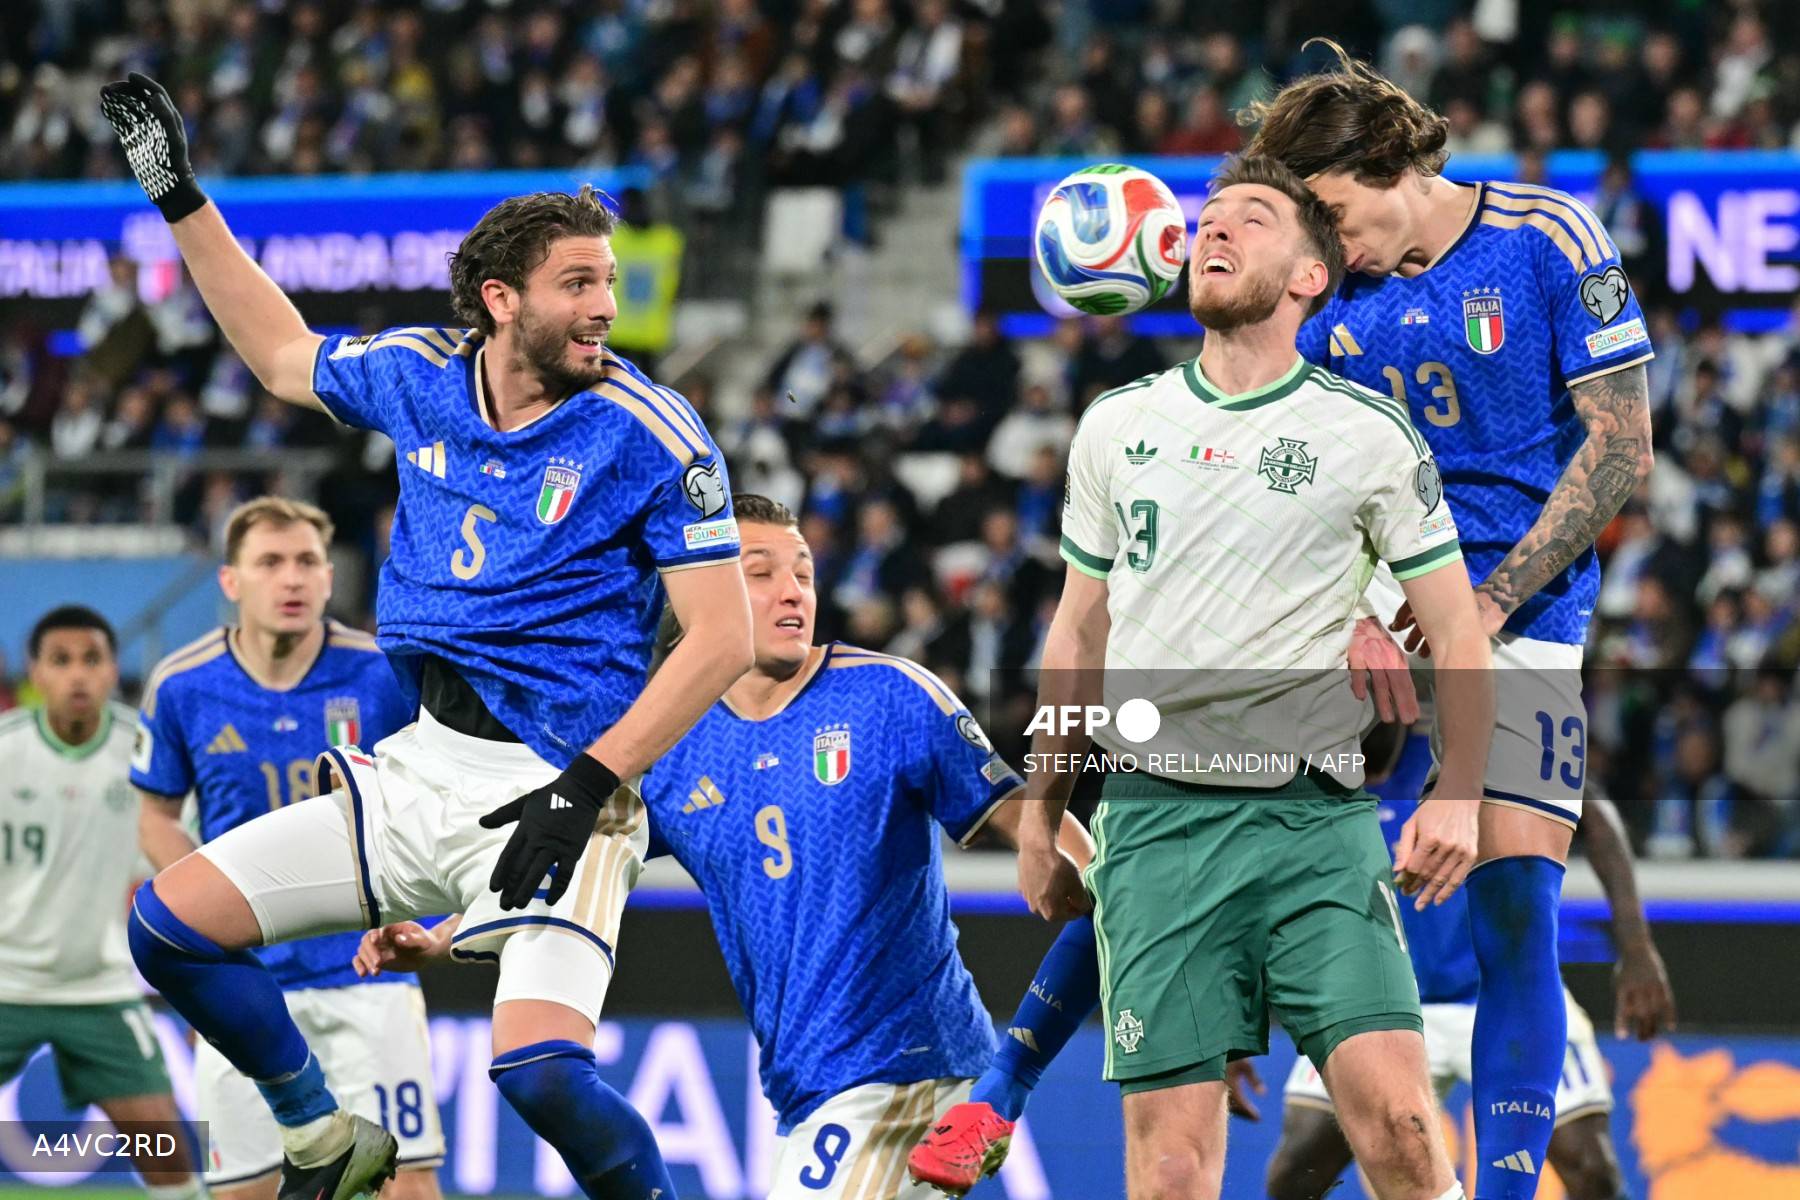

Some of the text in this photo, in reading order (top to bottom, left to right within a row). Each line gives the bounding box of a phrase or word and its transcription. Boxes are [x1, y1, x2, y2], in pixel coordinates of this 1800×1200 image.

[1467, 300, 1499, 313] ITALIA
[1383, 362, 1460, 427] 13
[547, 470, 576, 487] ITALIA
[450, 504, 497, 580] 5
[1536, 711, 1584, 790] 13
[4, 823, 46, 865] 19
[755, 805, 793, 880] 9
[374, 1081, 423, 1138] 18
[1491, 1101, 1551, 1119] ITALIA
[800, 1123, 851, 1190] 9
